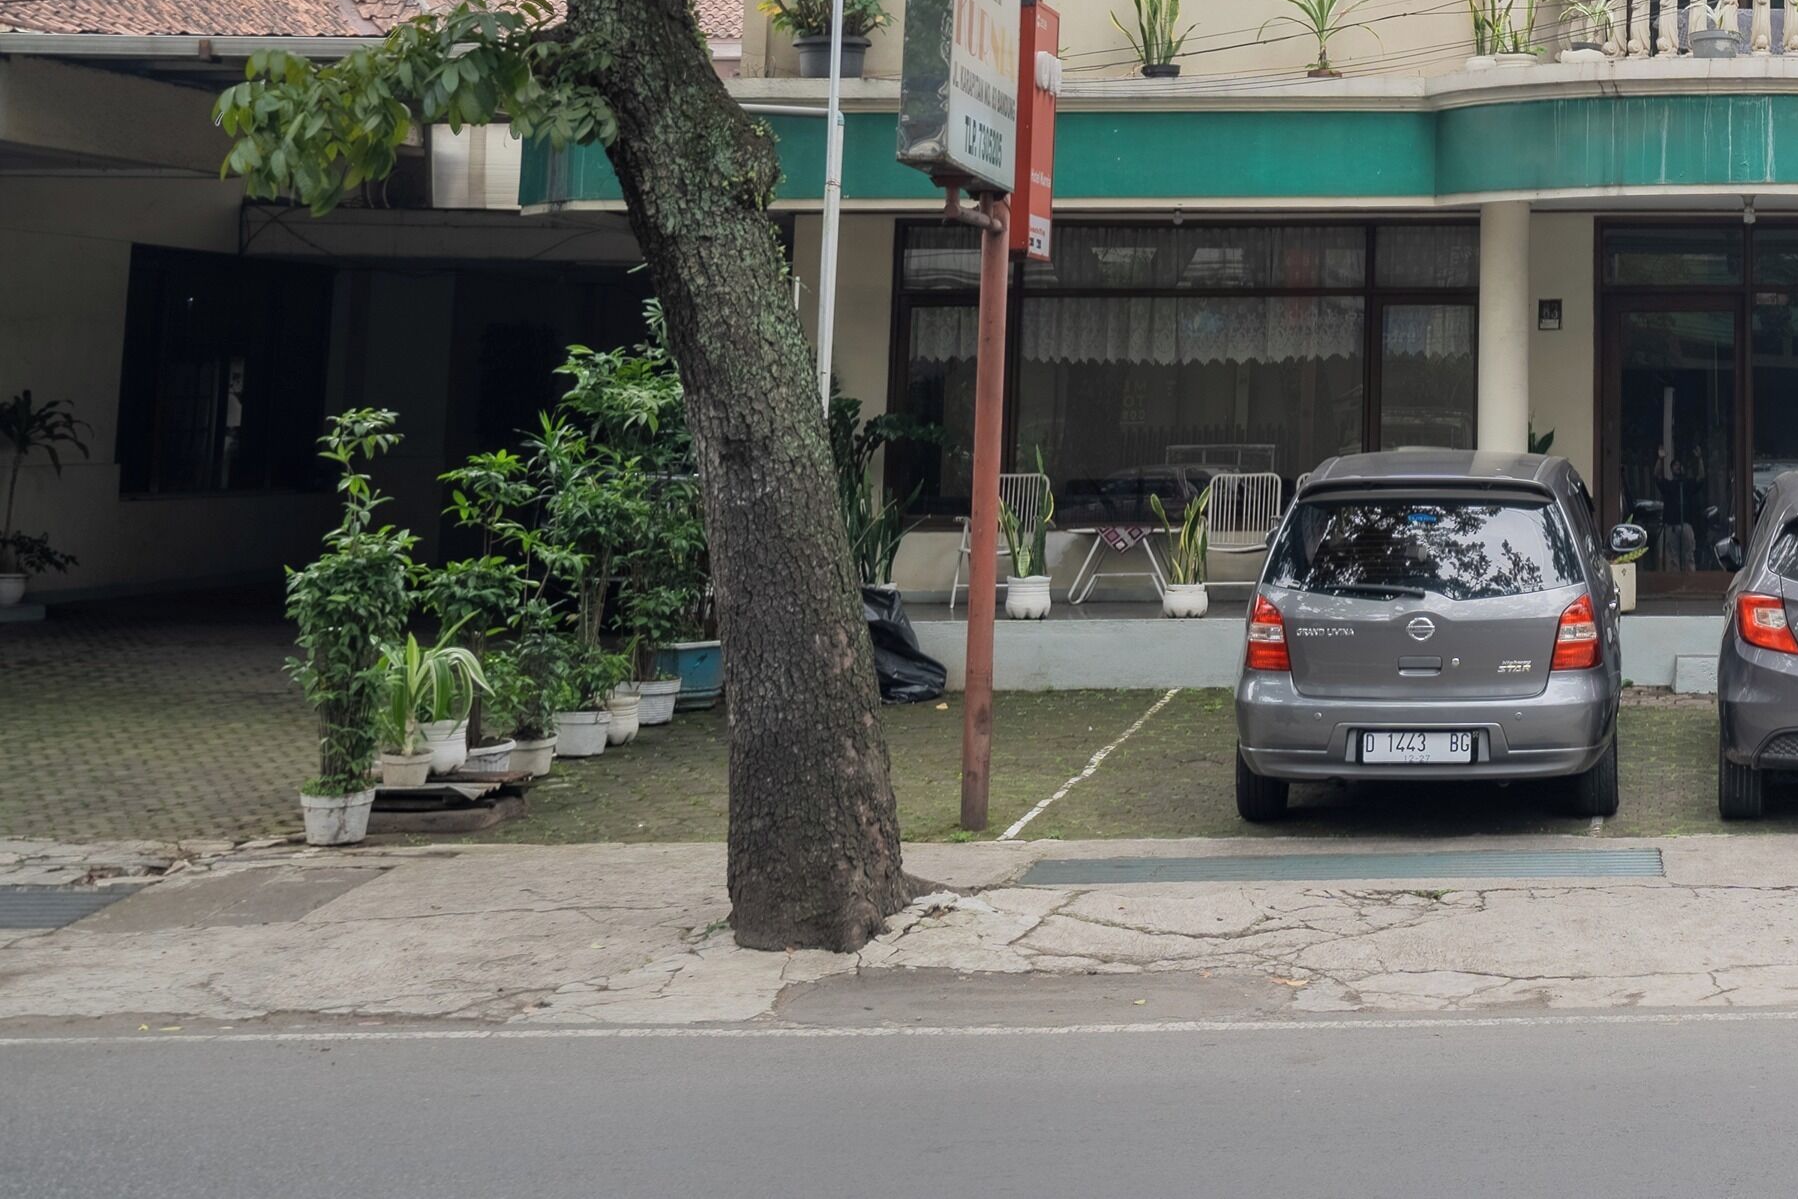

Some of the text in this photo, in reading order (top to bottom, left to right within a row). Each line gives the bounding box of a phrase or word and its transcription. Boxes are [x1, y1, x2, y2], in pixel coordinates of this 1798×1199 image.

[1497, 664, 1532, 673] STAR
[1365, 733, 1470, 753] D 1443 BG
